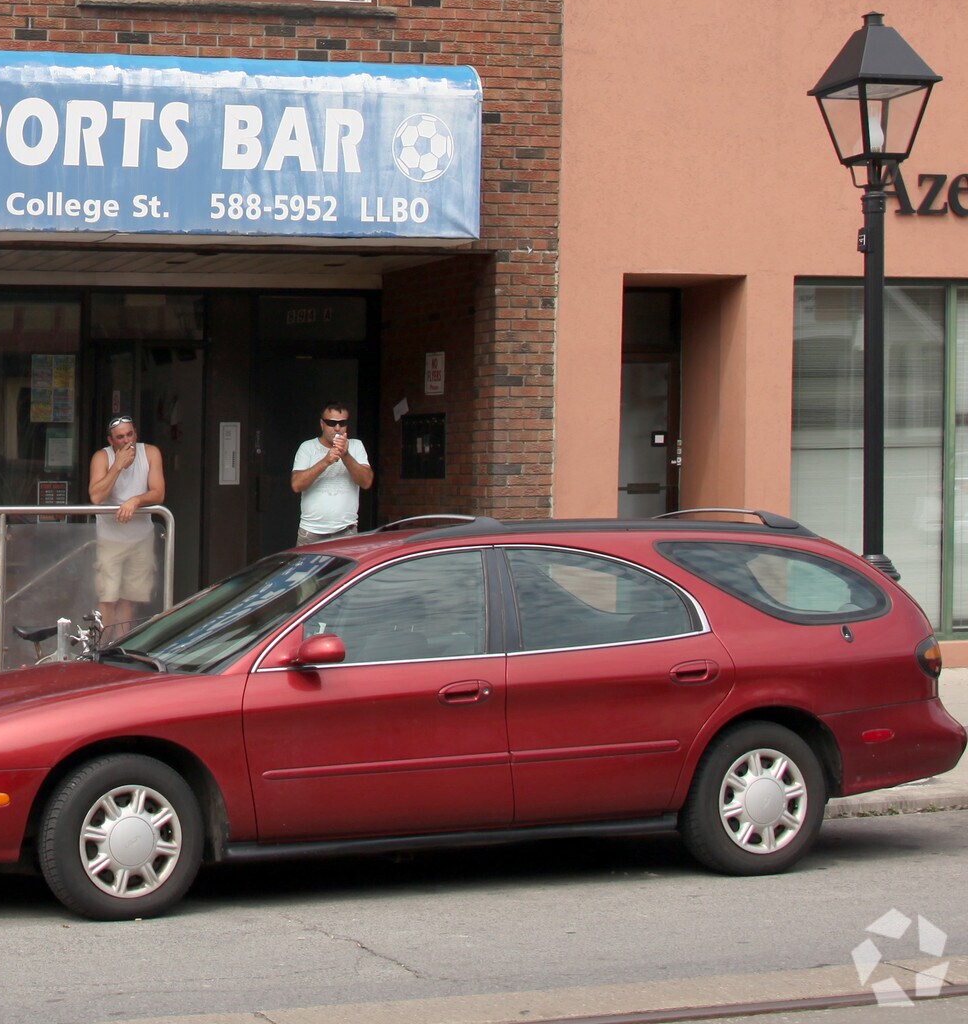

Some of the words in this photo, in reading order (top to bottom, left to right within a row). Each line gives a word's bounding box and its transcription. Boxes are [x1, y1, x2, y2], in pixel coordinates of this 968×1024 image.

[221, 104, 365, 174] BAR
[6, 191, 120, 224] College
[132, 193, 170, 220] St.
[210, 192, 338, 223] 588-5952
[360, 195, 430, 224] LLBO
